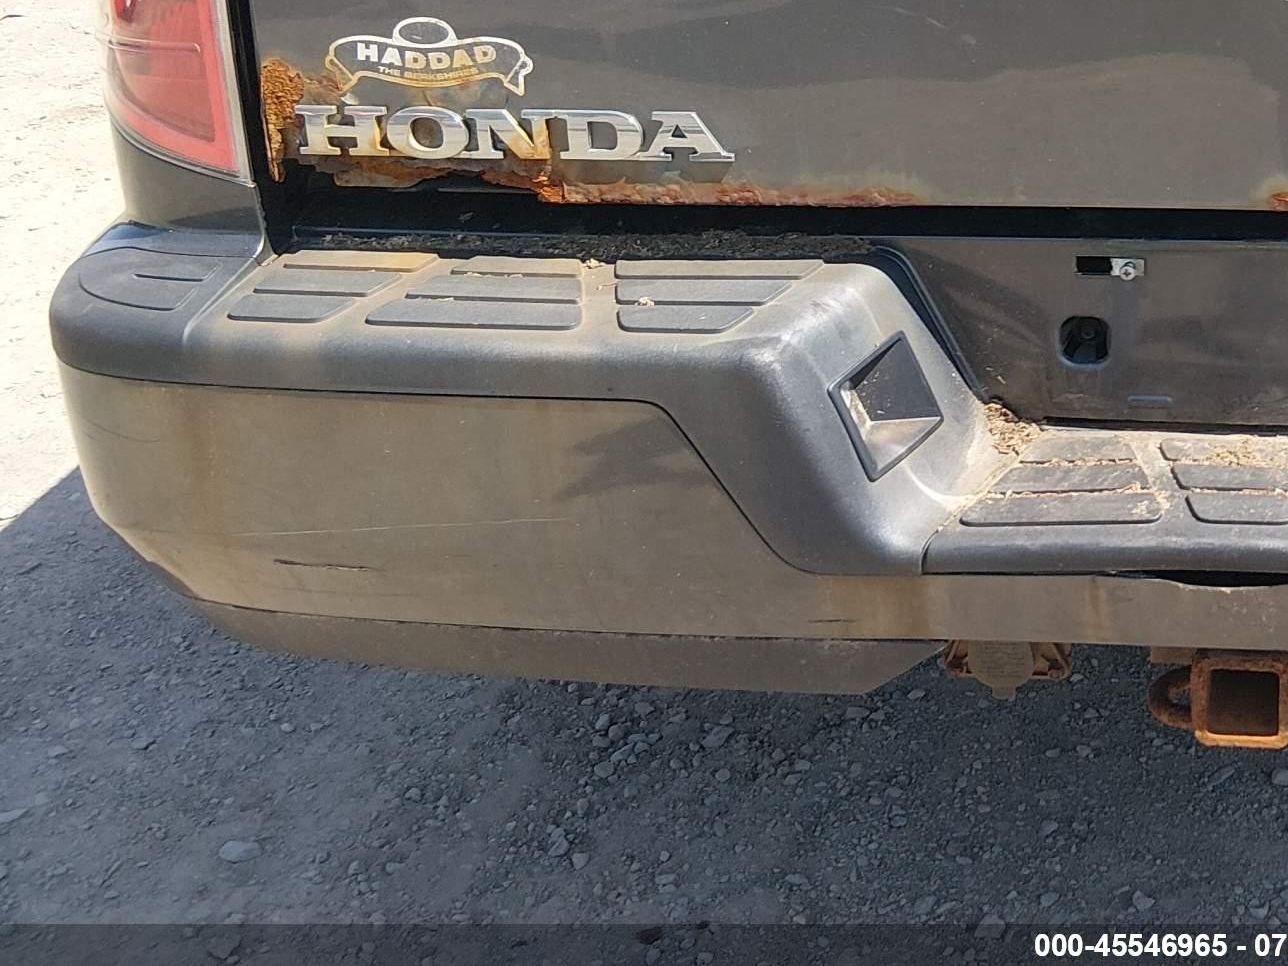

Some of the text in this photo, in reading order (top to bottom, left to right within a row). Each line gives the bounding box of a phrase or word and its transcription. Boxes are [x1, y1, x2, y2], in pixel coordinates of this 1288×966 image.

[356, 42, 497, 70] HADDAD
[378, 66, 480, 81] THE BERKSHIRES
[295, 105, 736, 162] HONDA
